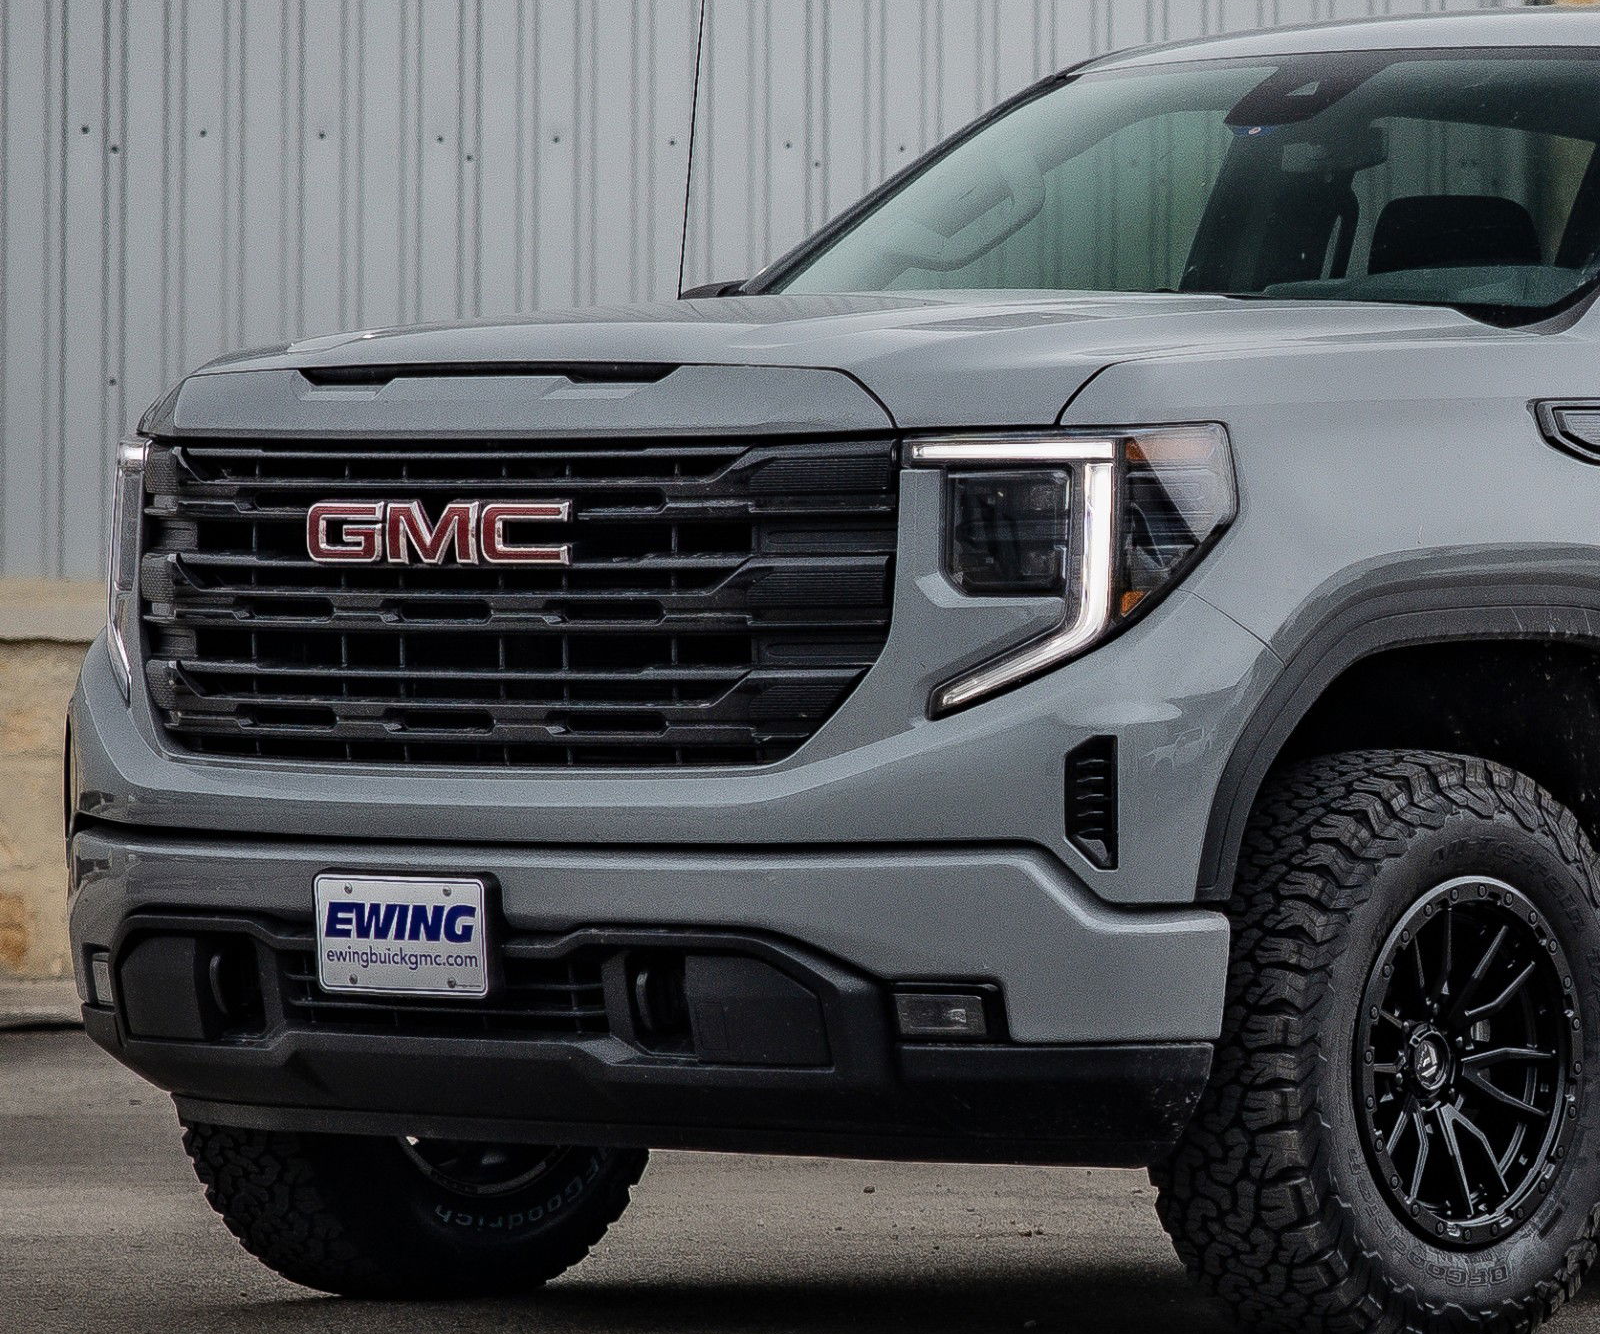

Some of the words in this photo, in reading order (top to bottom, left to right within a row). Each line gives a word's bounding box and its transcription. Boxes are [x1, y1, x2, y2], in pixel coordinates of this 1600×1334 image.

[306, 498, 573, 566] GMC
[325, 901, 477, 943] EWING
[327, 945, 479, 971] ewingbuickgmc.com
[433, 1146, 607, 1231] FGoodrich
